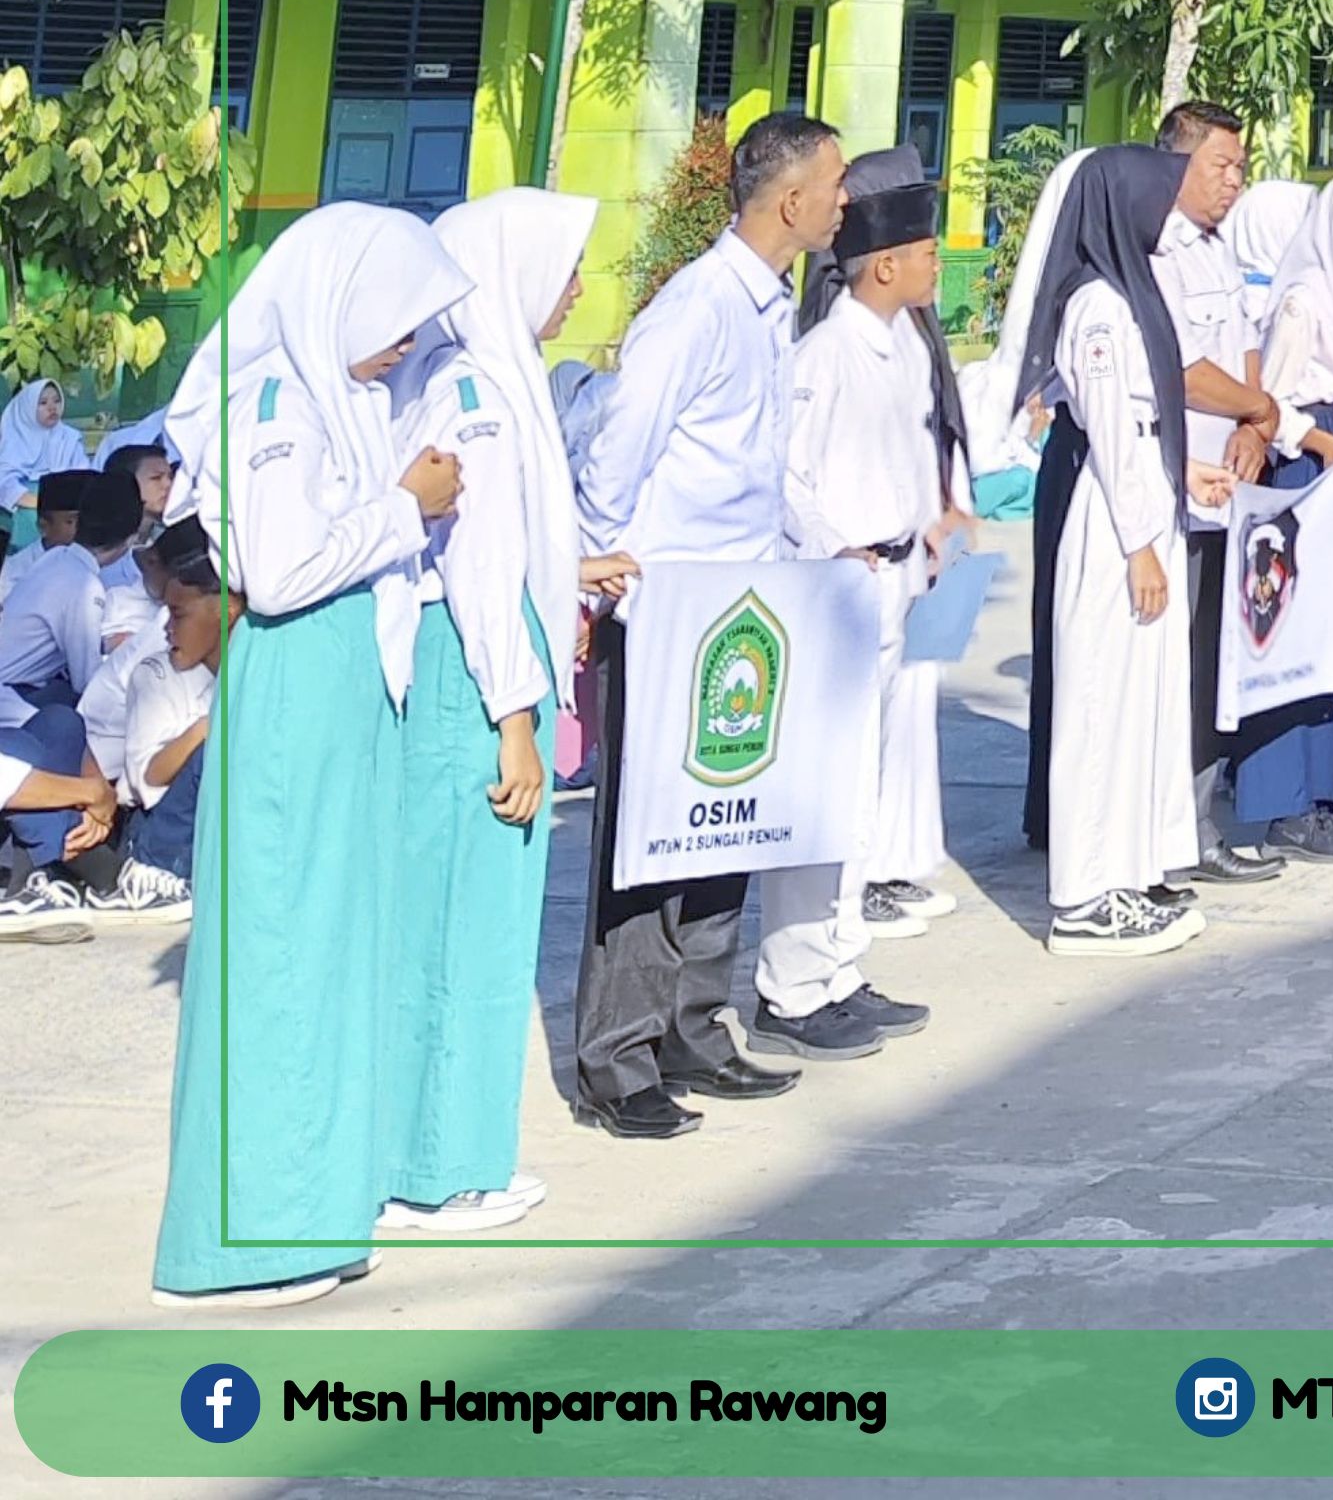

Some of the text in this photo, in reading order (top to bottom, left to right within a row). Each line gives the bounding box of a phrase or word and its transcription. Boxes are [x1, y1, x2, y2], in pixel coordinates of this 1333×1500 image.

[689, 797, 757, 828] OSIM
[647, 826, 793, 855] MTsN 2 SUNGAI PENUH
